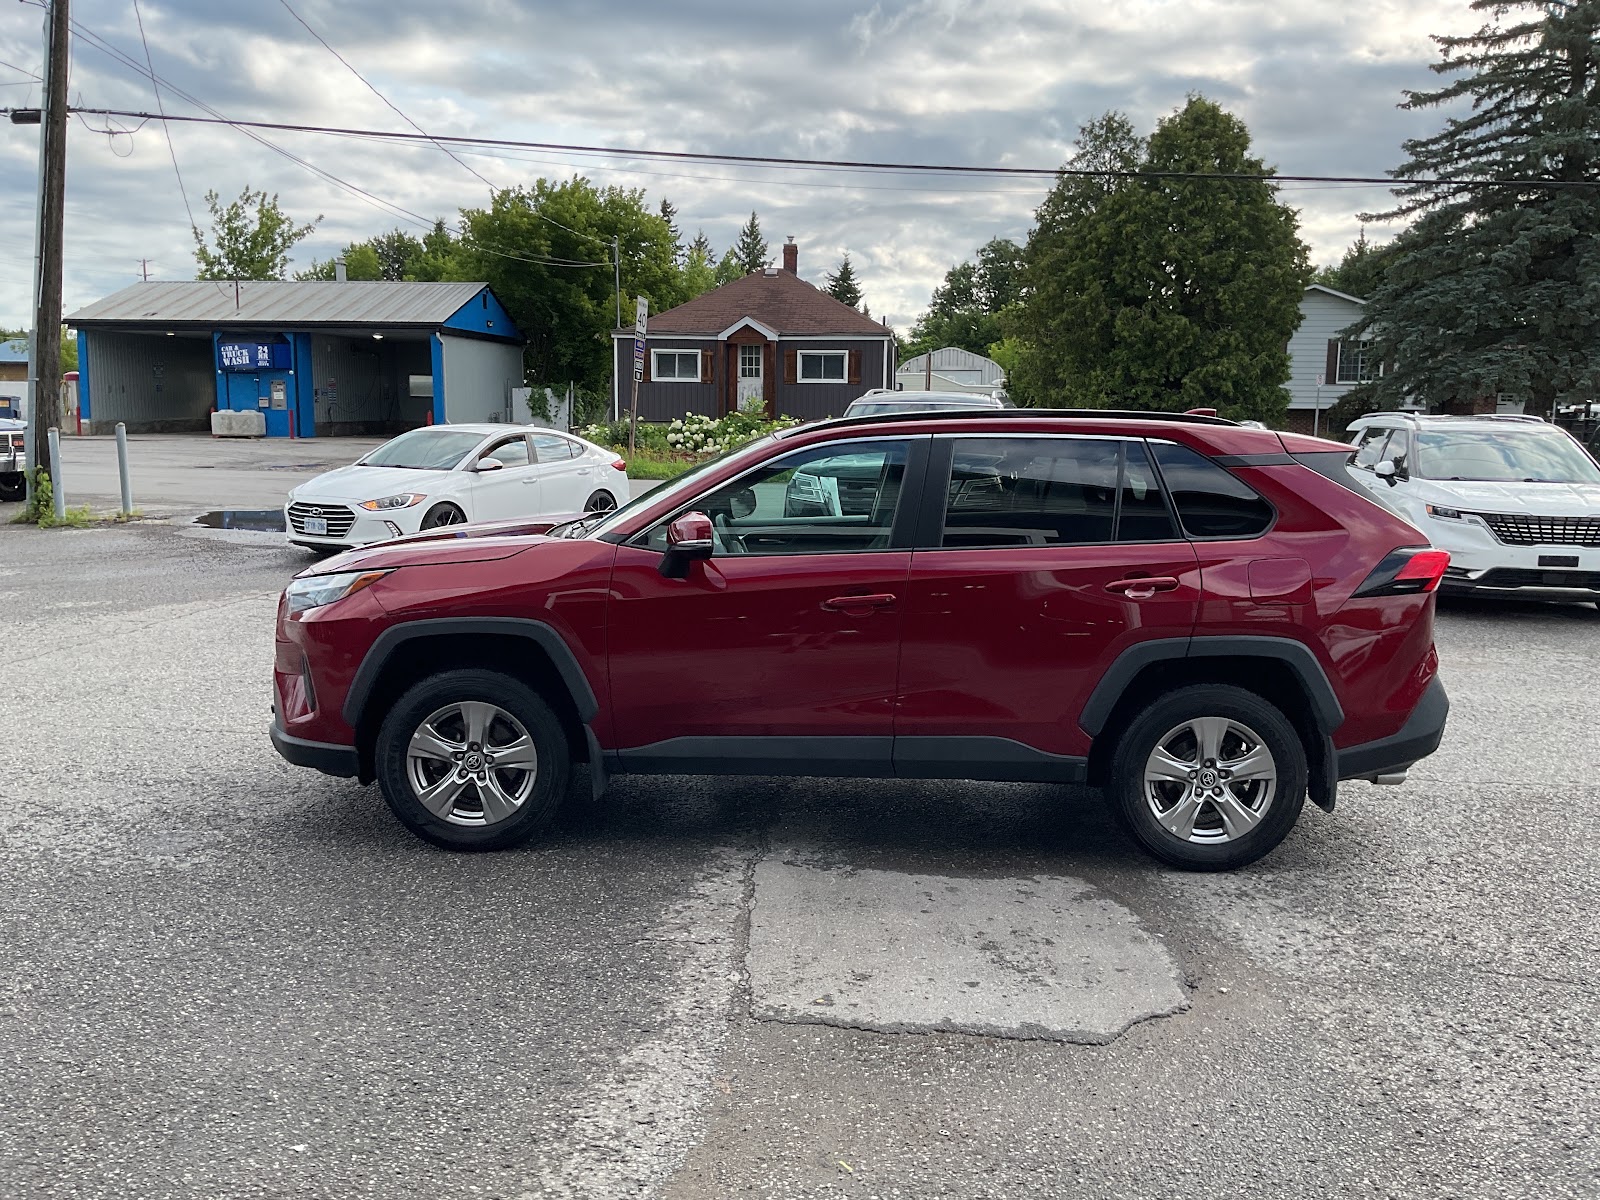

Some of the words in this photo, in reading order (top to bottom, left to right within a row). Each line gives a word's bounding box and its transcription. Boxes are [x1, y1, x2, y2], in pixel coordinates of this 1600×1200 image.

[637, 313, 646, 327] 40
[221, 349, 249, 358] TRUCK
[223, 356, 250, 366] WASH
